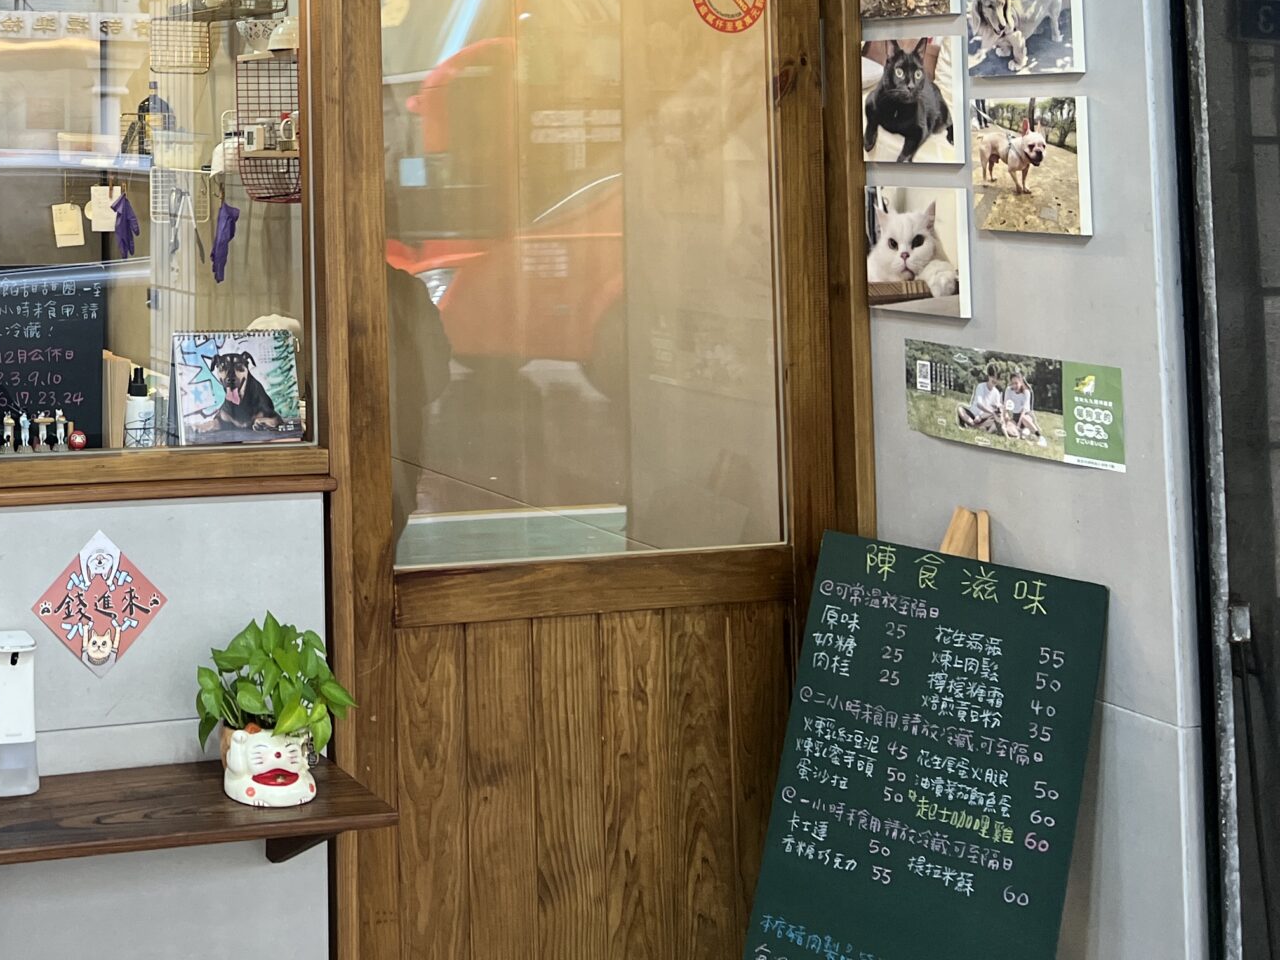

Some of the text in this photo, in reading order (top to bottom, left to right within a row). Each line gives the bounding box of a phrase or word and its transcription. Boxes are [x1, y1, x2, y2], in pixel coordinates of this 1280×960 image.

[54, 586, 152, 623] 錢進來
[865, 544, 1047, 615] 陳食滋味
[812, 632, 858, 658] 奶糖
[881, 646, 904, 663] 25
[1035, 672, 1062, 693] 50
[820, 605, 861, 632] 原味
[885, 622, 908, 639] 25
[1038, 647, 1065, 669] 55
[812, 652, 851, 677] 肉桂
[879, 669, 901, 686] 25
[1030, 700, 1056, 718] 40
[1028, 721, 1055, 742] 35
[886, 740, 910, 761] 45
[1033, 780, 1060, 800] 50
[886, 767, 907, 784] 50
[1029, 809, 1057, 829] 60
[796, 758, 1050, 853] 蛋沙拉 50 起士咖哩雞 60
[787, 810, 1030, 907] 卡士達 50 提拉米蘇 60
[871, 865, 893, 885] 55
